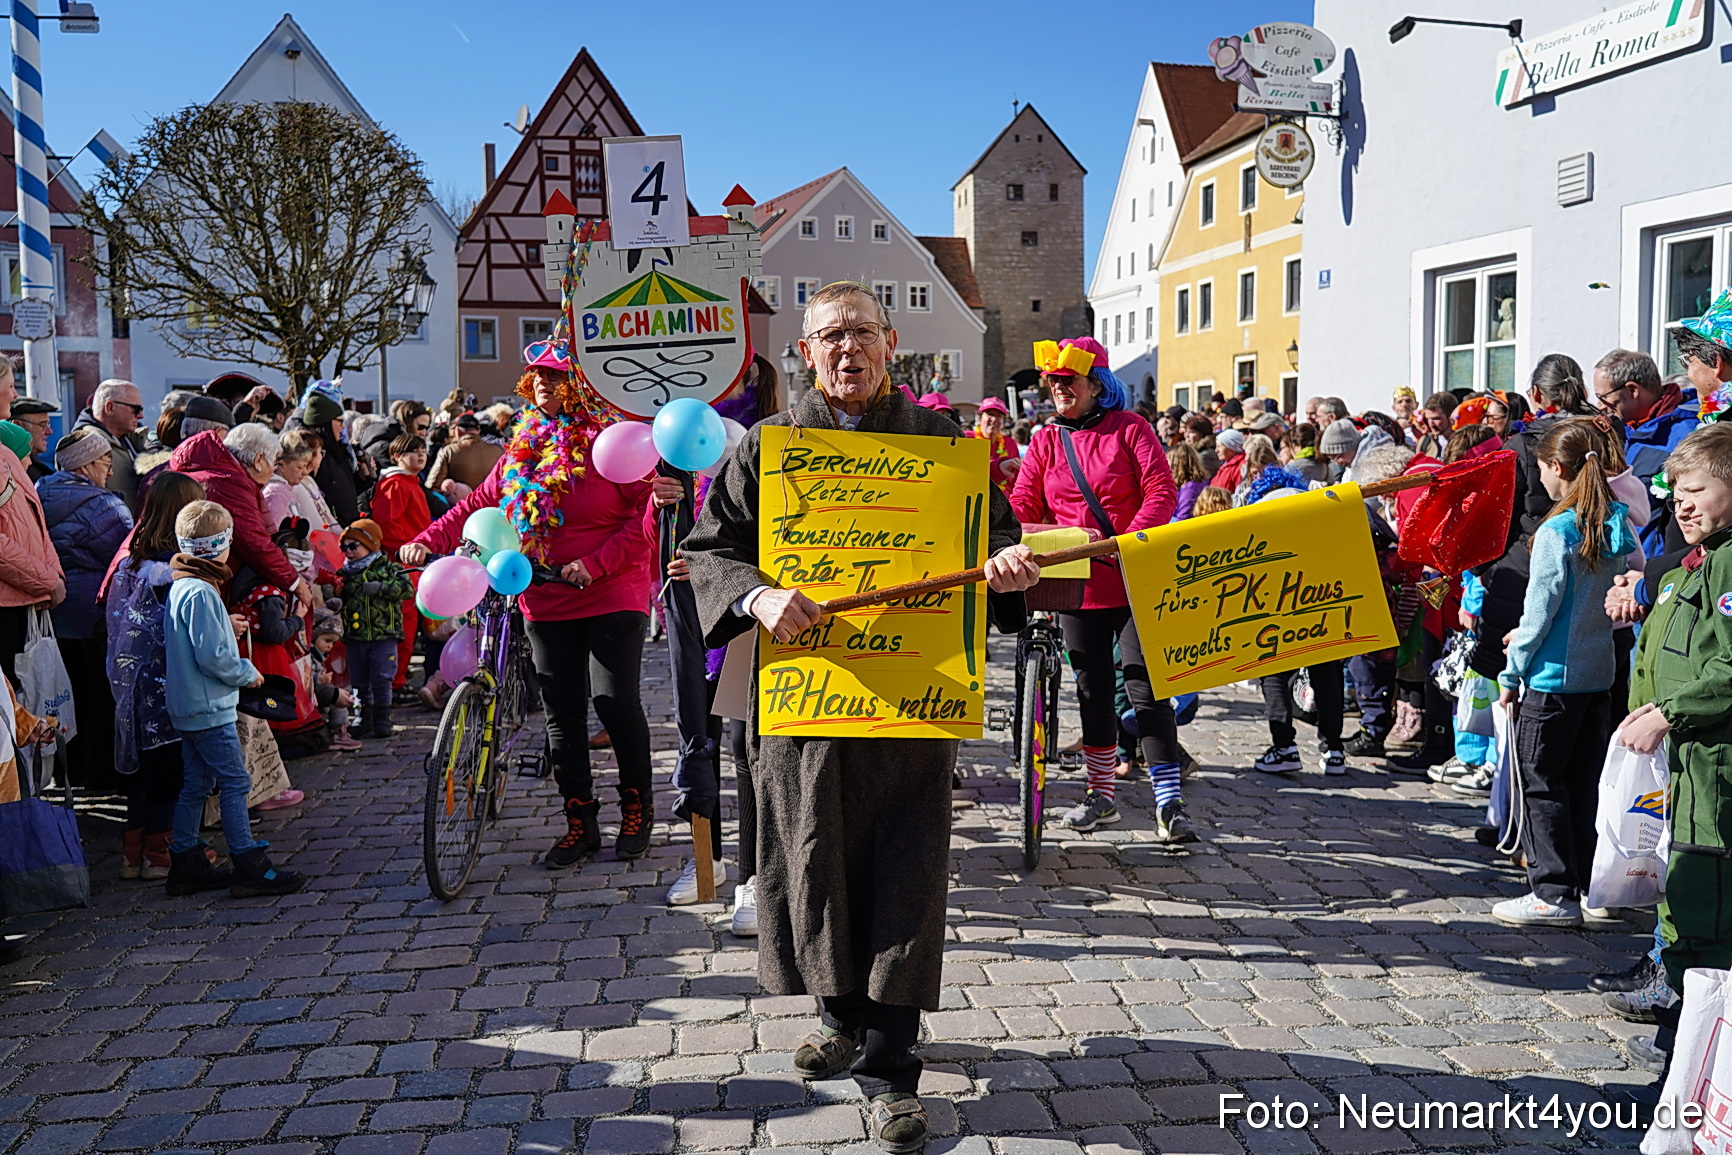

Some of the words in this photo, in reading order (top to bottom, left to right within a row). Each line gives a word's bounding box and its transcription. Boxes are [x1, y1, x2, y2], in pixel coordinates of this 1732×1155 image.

[1263, 25, 1313, 41] Pizzeria
[1533, 33, 1572, 53] Pizzeria
[1274, 44, 1301, 58] Café
[1526, 50, 1582, 90] Bella
[1588, 30, 1660, 69] Roma
[1260, 59, 1313, 77] Eisdiele
[1243, 95, 1283, 106] Roma
[1269, 89, 1305, 99] Bella
[630, 161, 669, 216] 4
[581, 305, 735, 341] BACHAMINIS
[799, 479, 890, 503] letzter
[1175, 533, 1268, 580] Spende
[846, 619, 903, 652] das
[895, 684, 968, 720] retten
